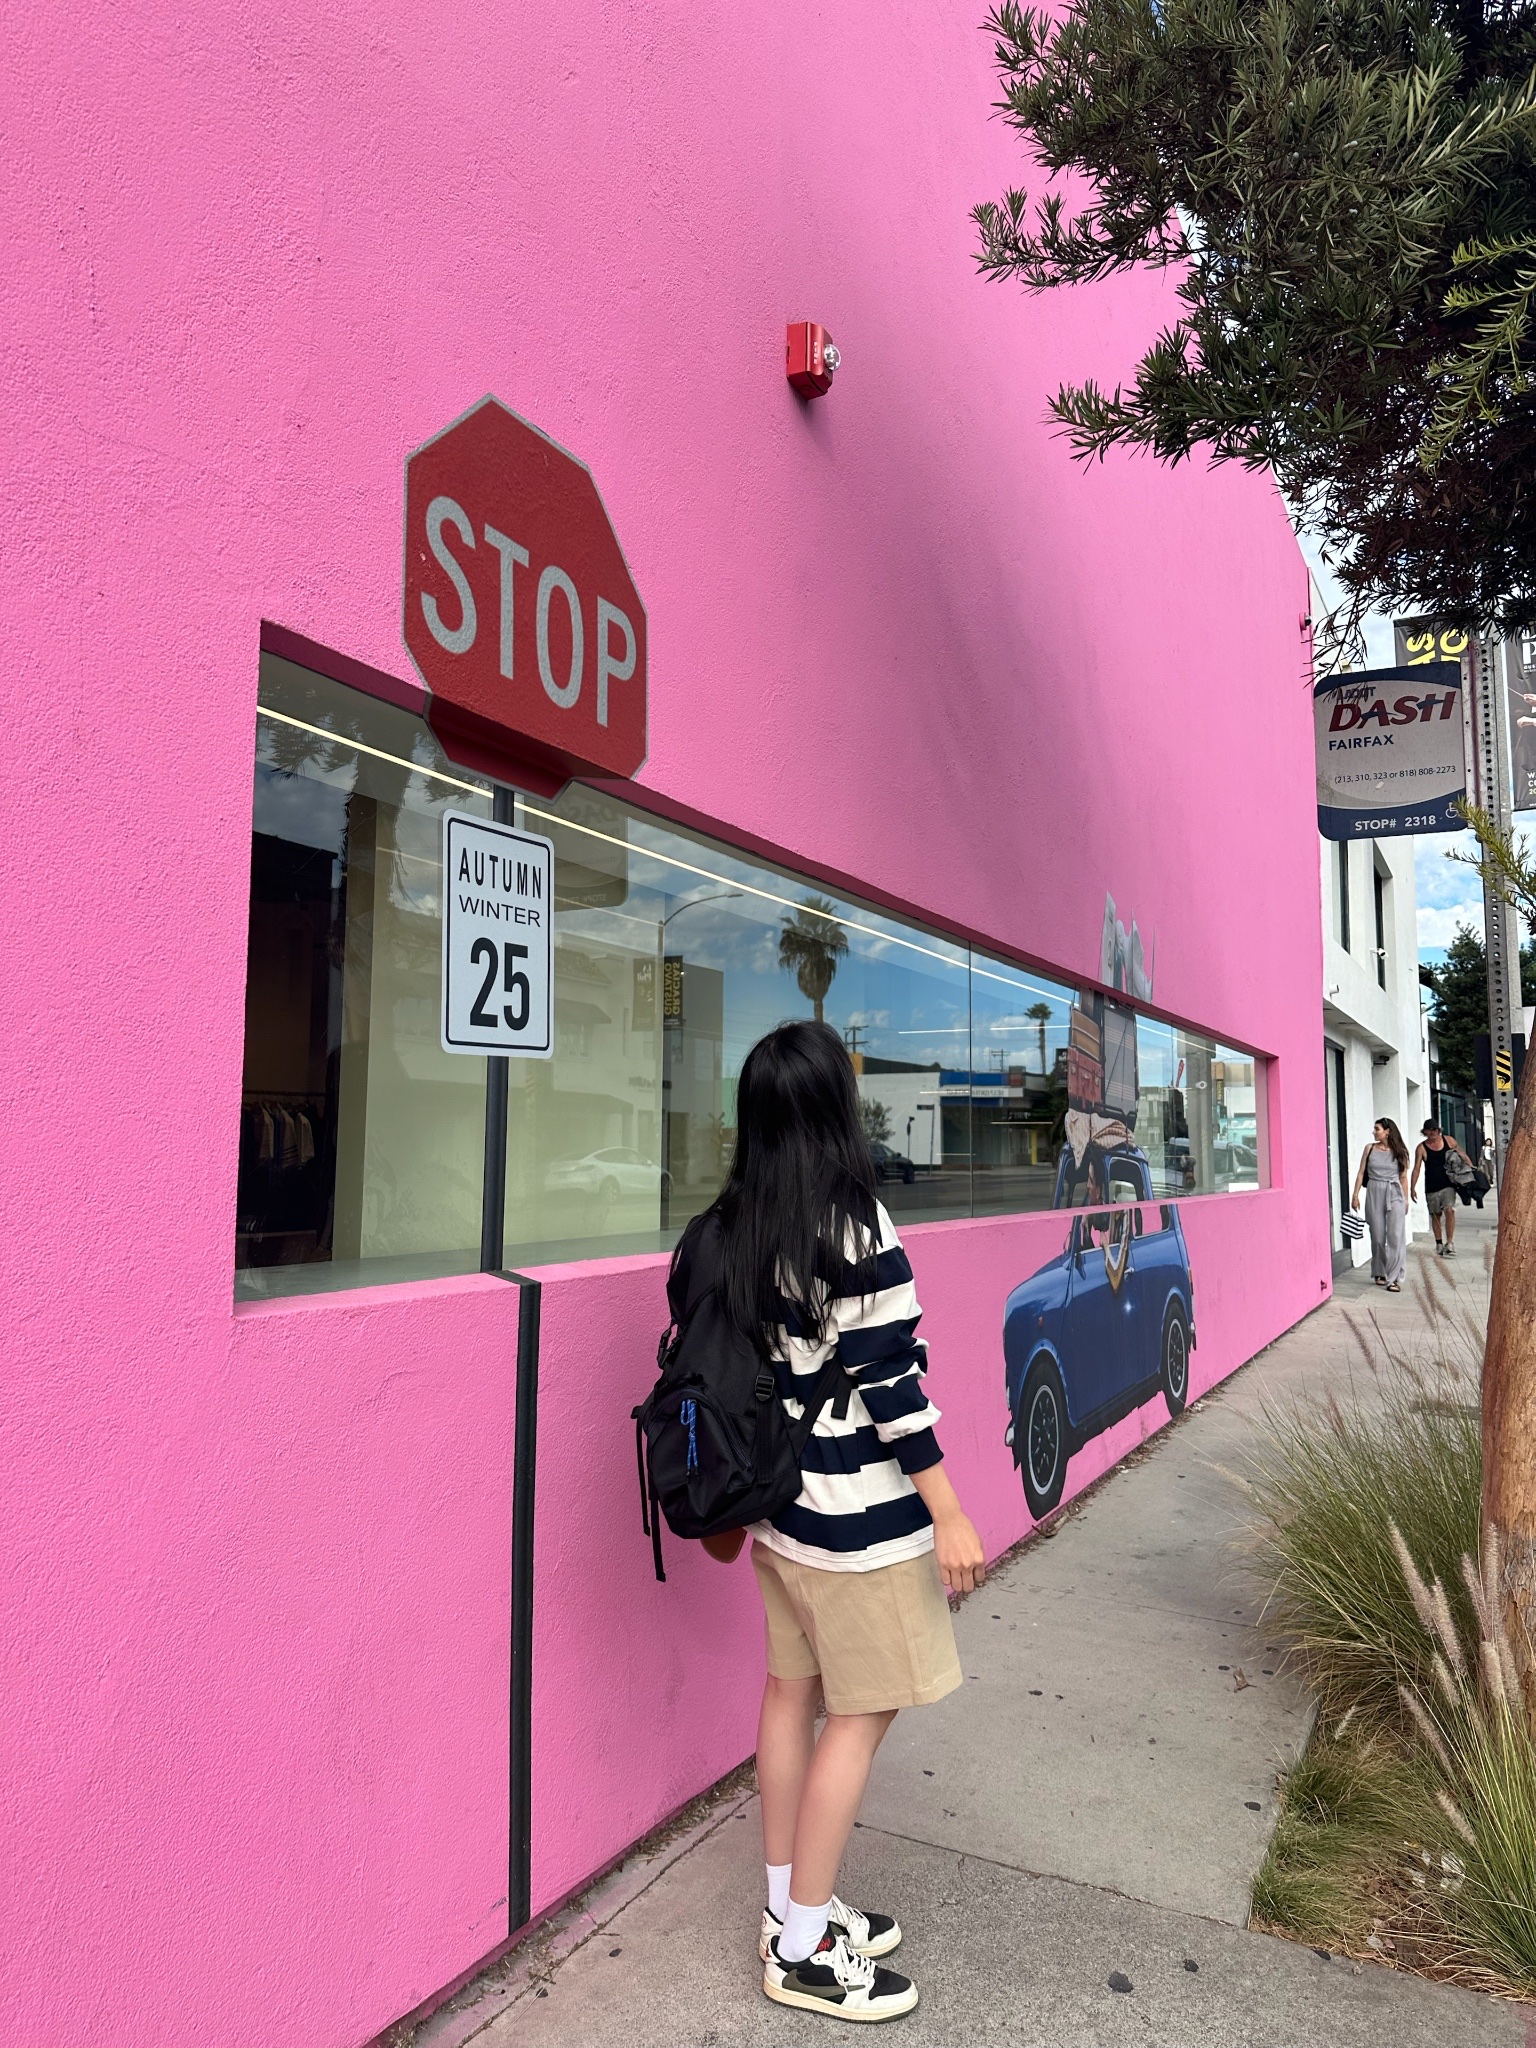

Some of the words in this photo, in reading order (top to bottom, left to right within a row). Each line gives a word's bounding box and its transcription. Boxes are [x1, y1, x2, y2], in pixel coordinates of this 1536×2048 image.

[421, 496, 637, 728] STOP
[1328, 691, 1457, 732] DASH
[1328, 734, 1395, 751] FAIRFAX
[1334, 776, 1353, 784] (213,
[1355, 773, 1372, 782] 310,
[1373, 771, 1388, 780] 323
[1399, 768, 1417, 778] 818)
[1418, 765, 1456, 776] 808-2273
[1354, 818, 1397, 831] STOP#
[1404, 815, 1437, 827] 2318
[458, 847, 541, 899] AUTUMN
[458, 894, 541, 927] WINTER
[469, 937, 530, 1031] 25
